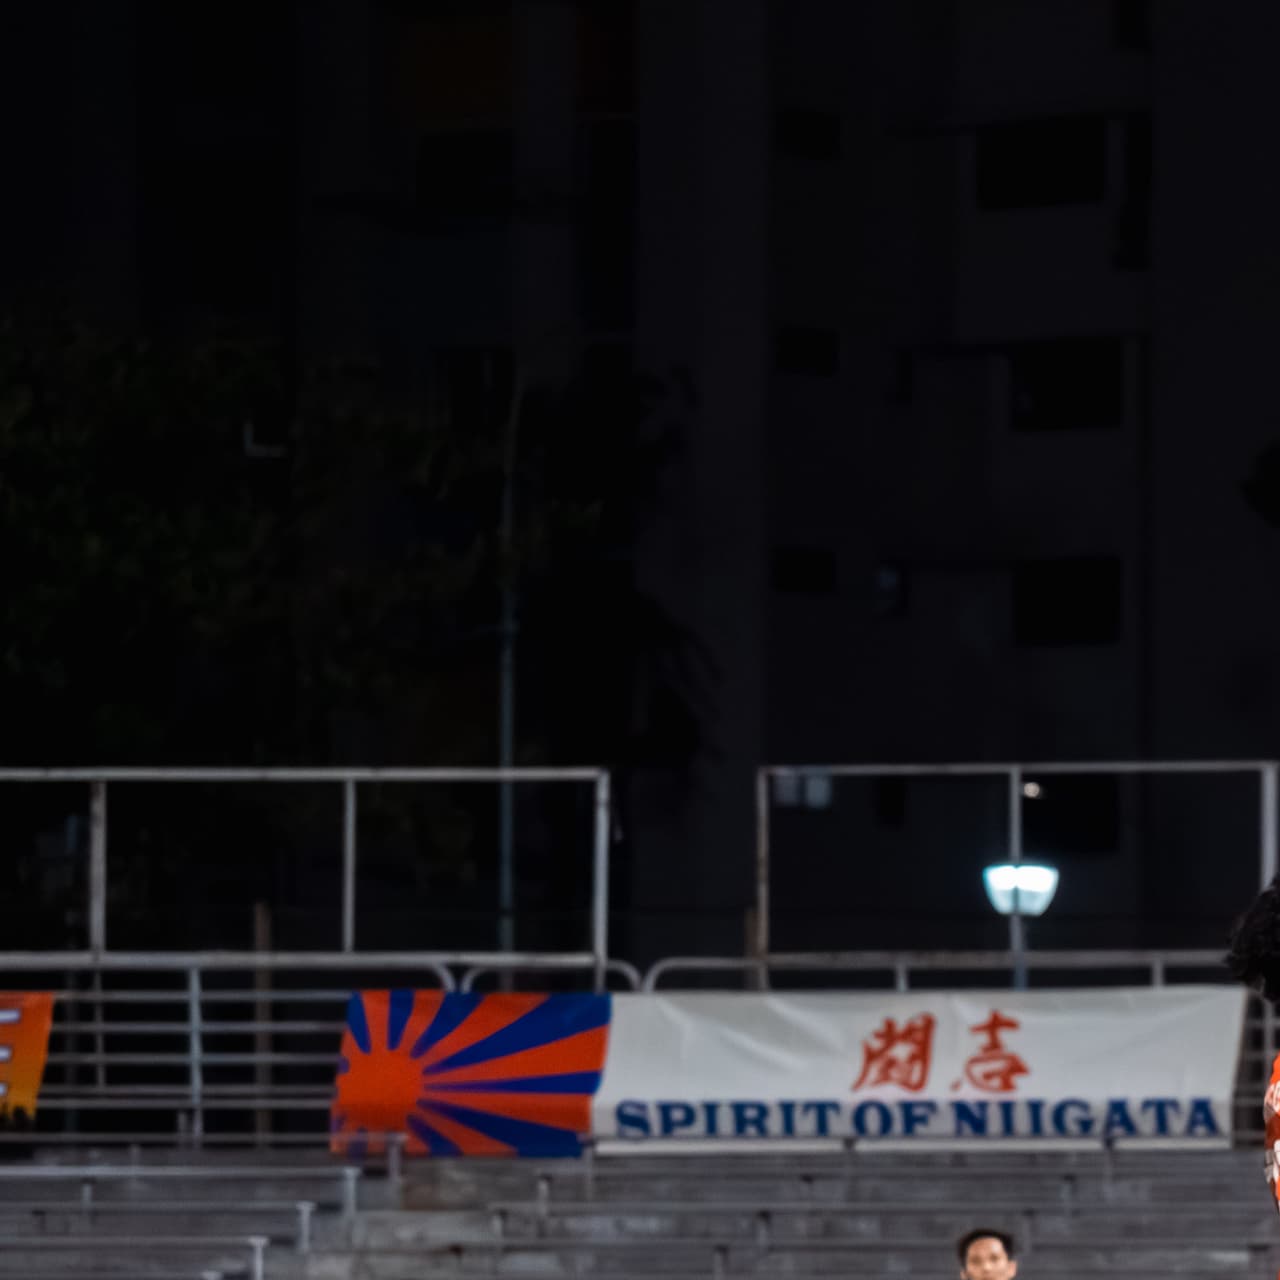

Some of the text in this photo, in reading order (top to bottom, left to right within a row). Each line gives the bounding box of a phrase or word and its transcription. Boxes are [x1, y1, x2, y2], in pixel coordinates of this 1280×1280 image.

[614, 1098, 841, 1139] SPIRIT
[851, 1098, 939, 1138] OF
[948, 1096, 1220, 1137] NIIGATA
